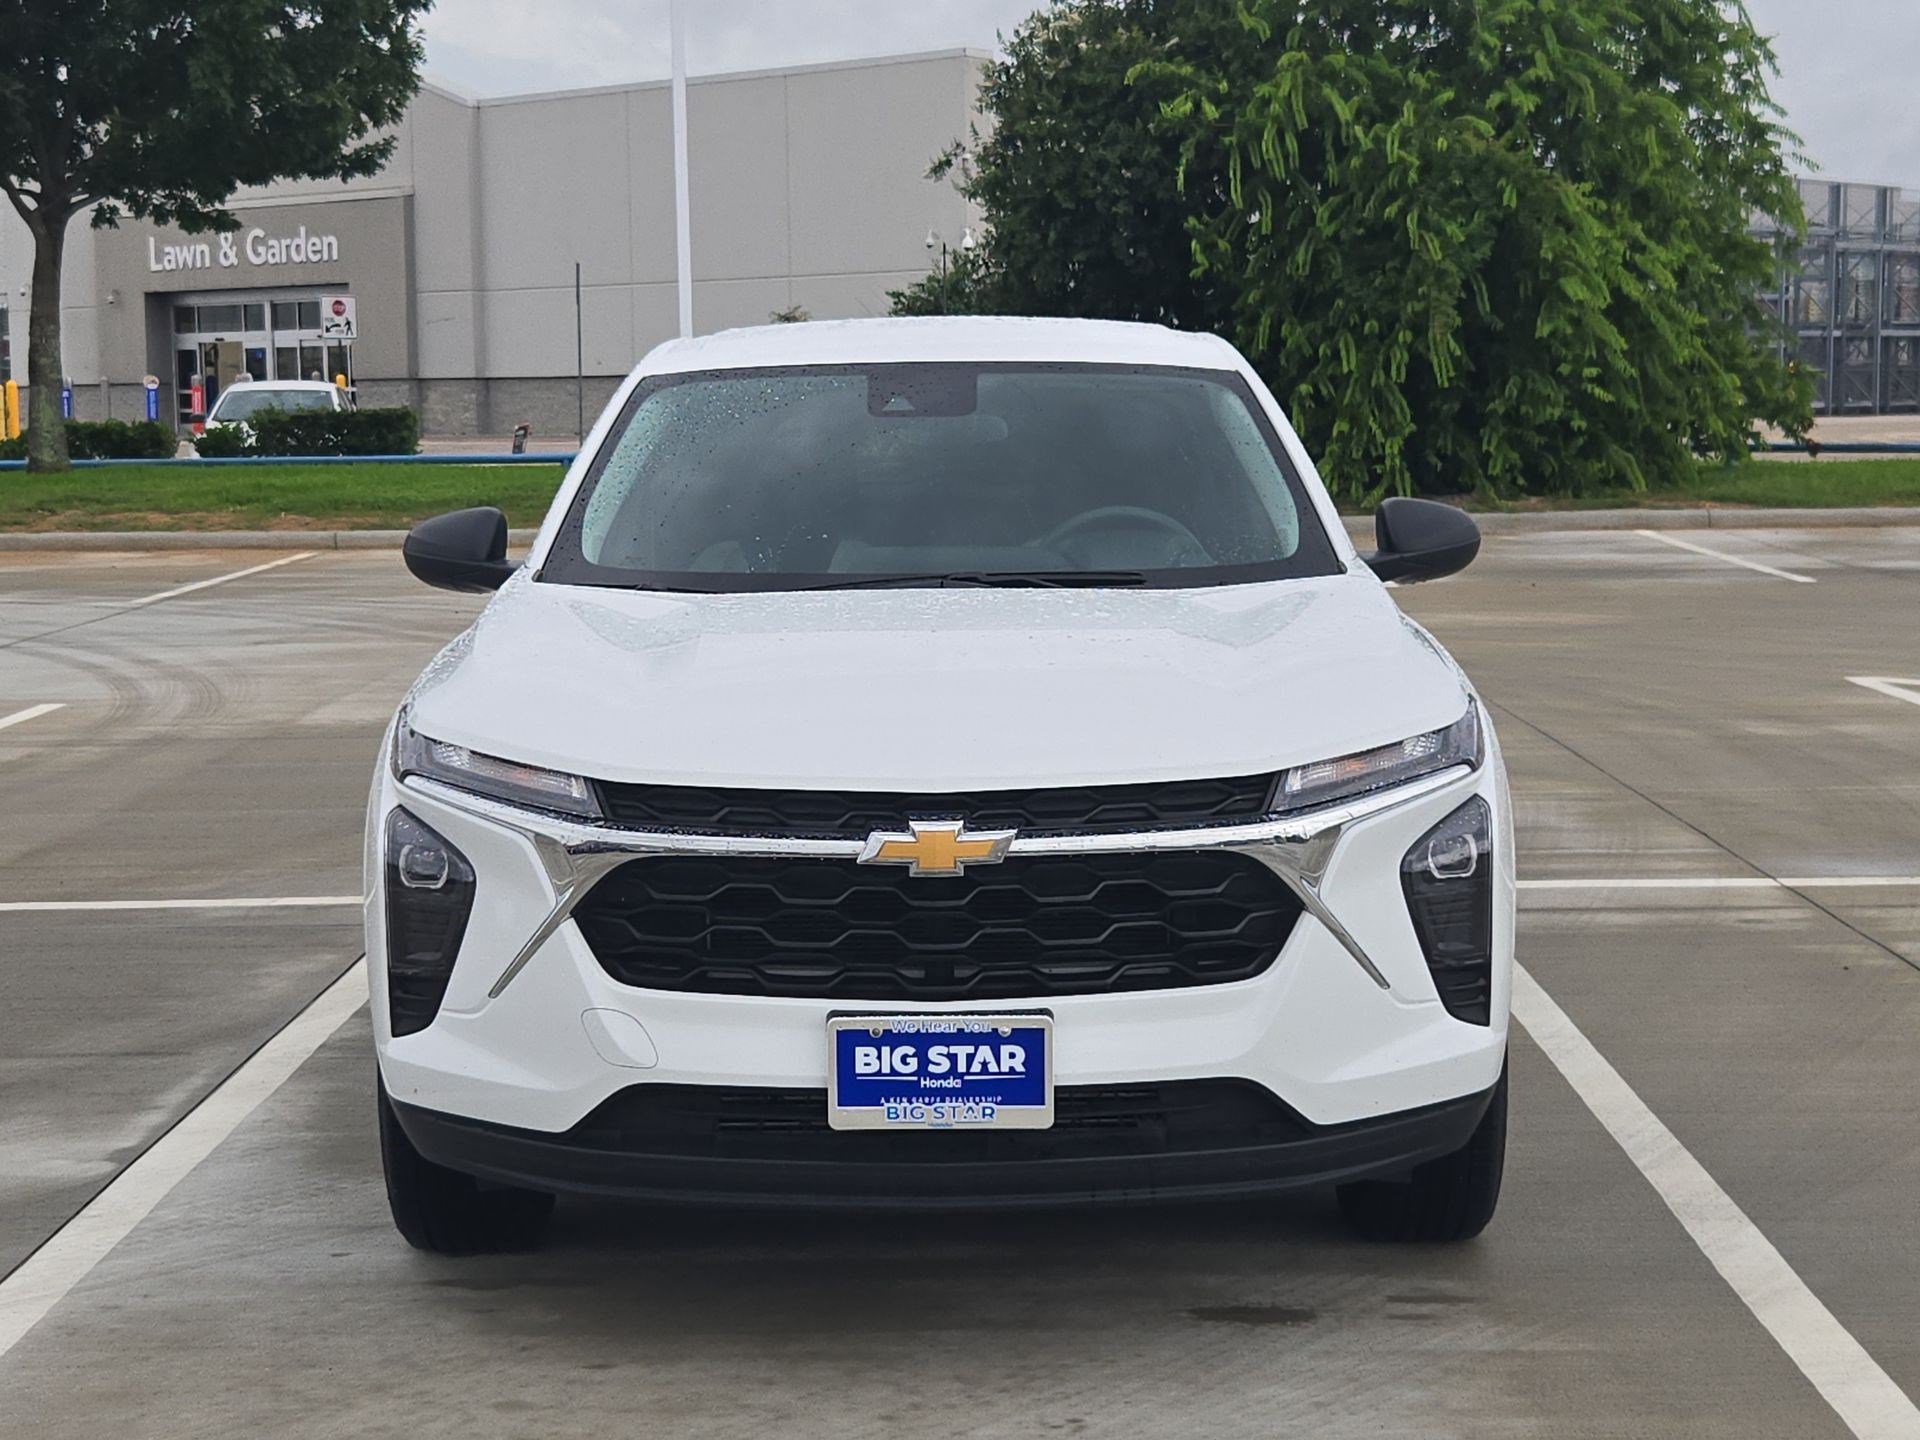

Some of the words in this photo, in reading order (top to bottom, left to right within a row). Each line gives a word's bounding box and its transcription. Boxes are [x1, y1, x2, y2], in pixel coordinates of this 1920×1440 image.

[149, 236, 211, 272] Lawn
[218, 231, 239, 268] &
[246, 226, 339, 266] Garden
[891, 1020, 918, 1034] We
[921, 1020, 957, 1034] Hear
[963, 1020, 992, 1034] You
[855, 1046, 918, 1074] BIG
[927, 1045, 1026, 1074] STAR
[920, 1076, 962, 1089] Honda
[886, 1105, 926, 1120] BIG
[933, 1105, 996, 1120] STAR
